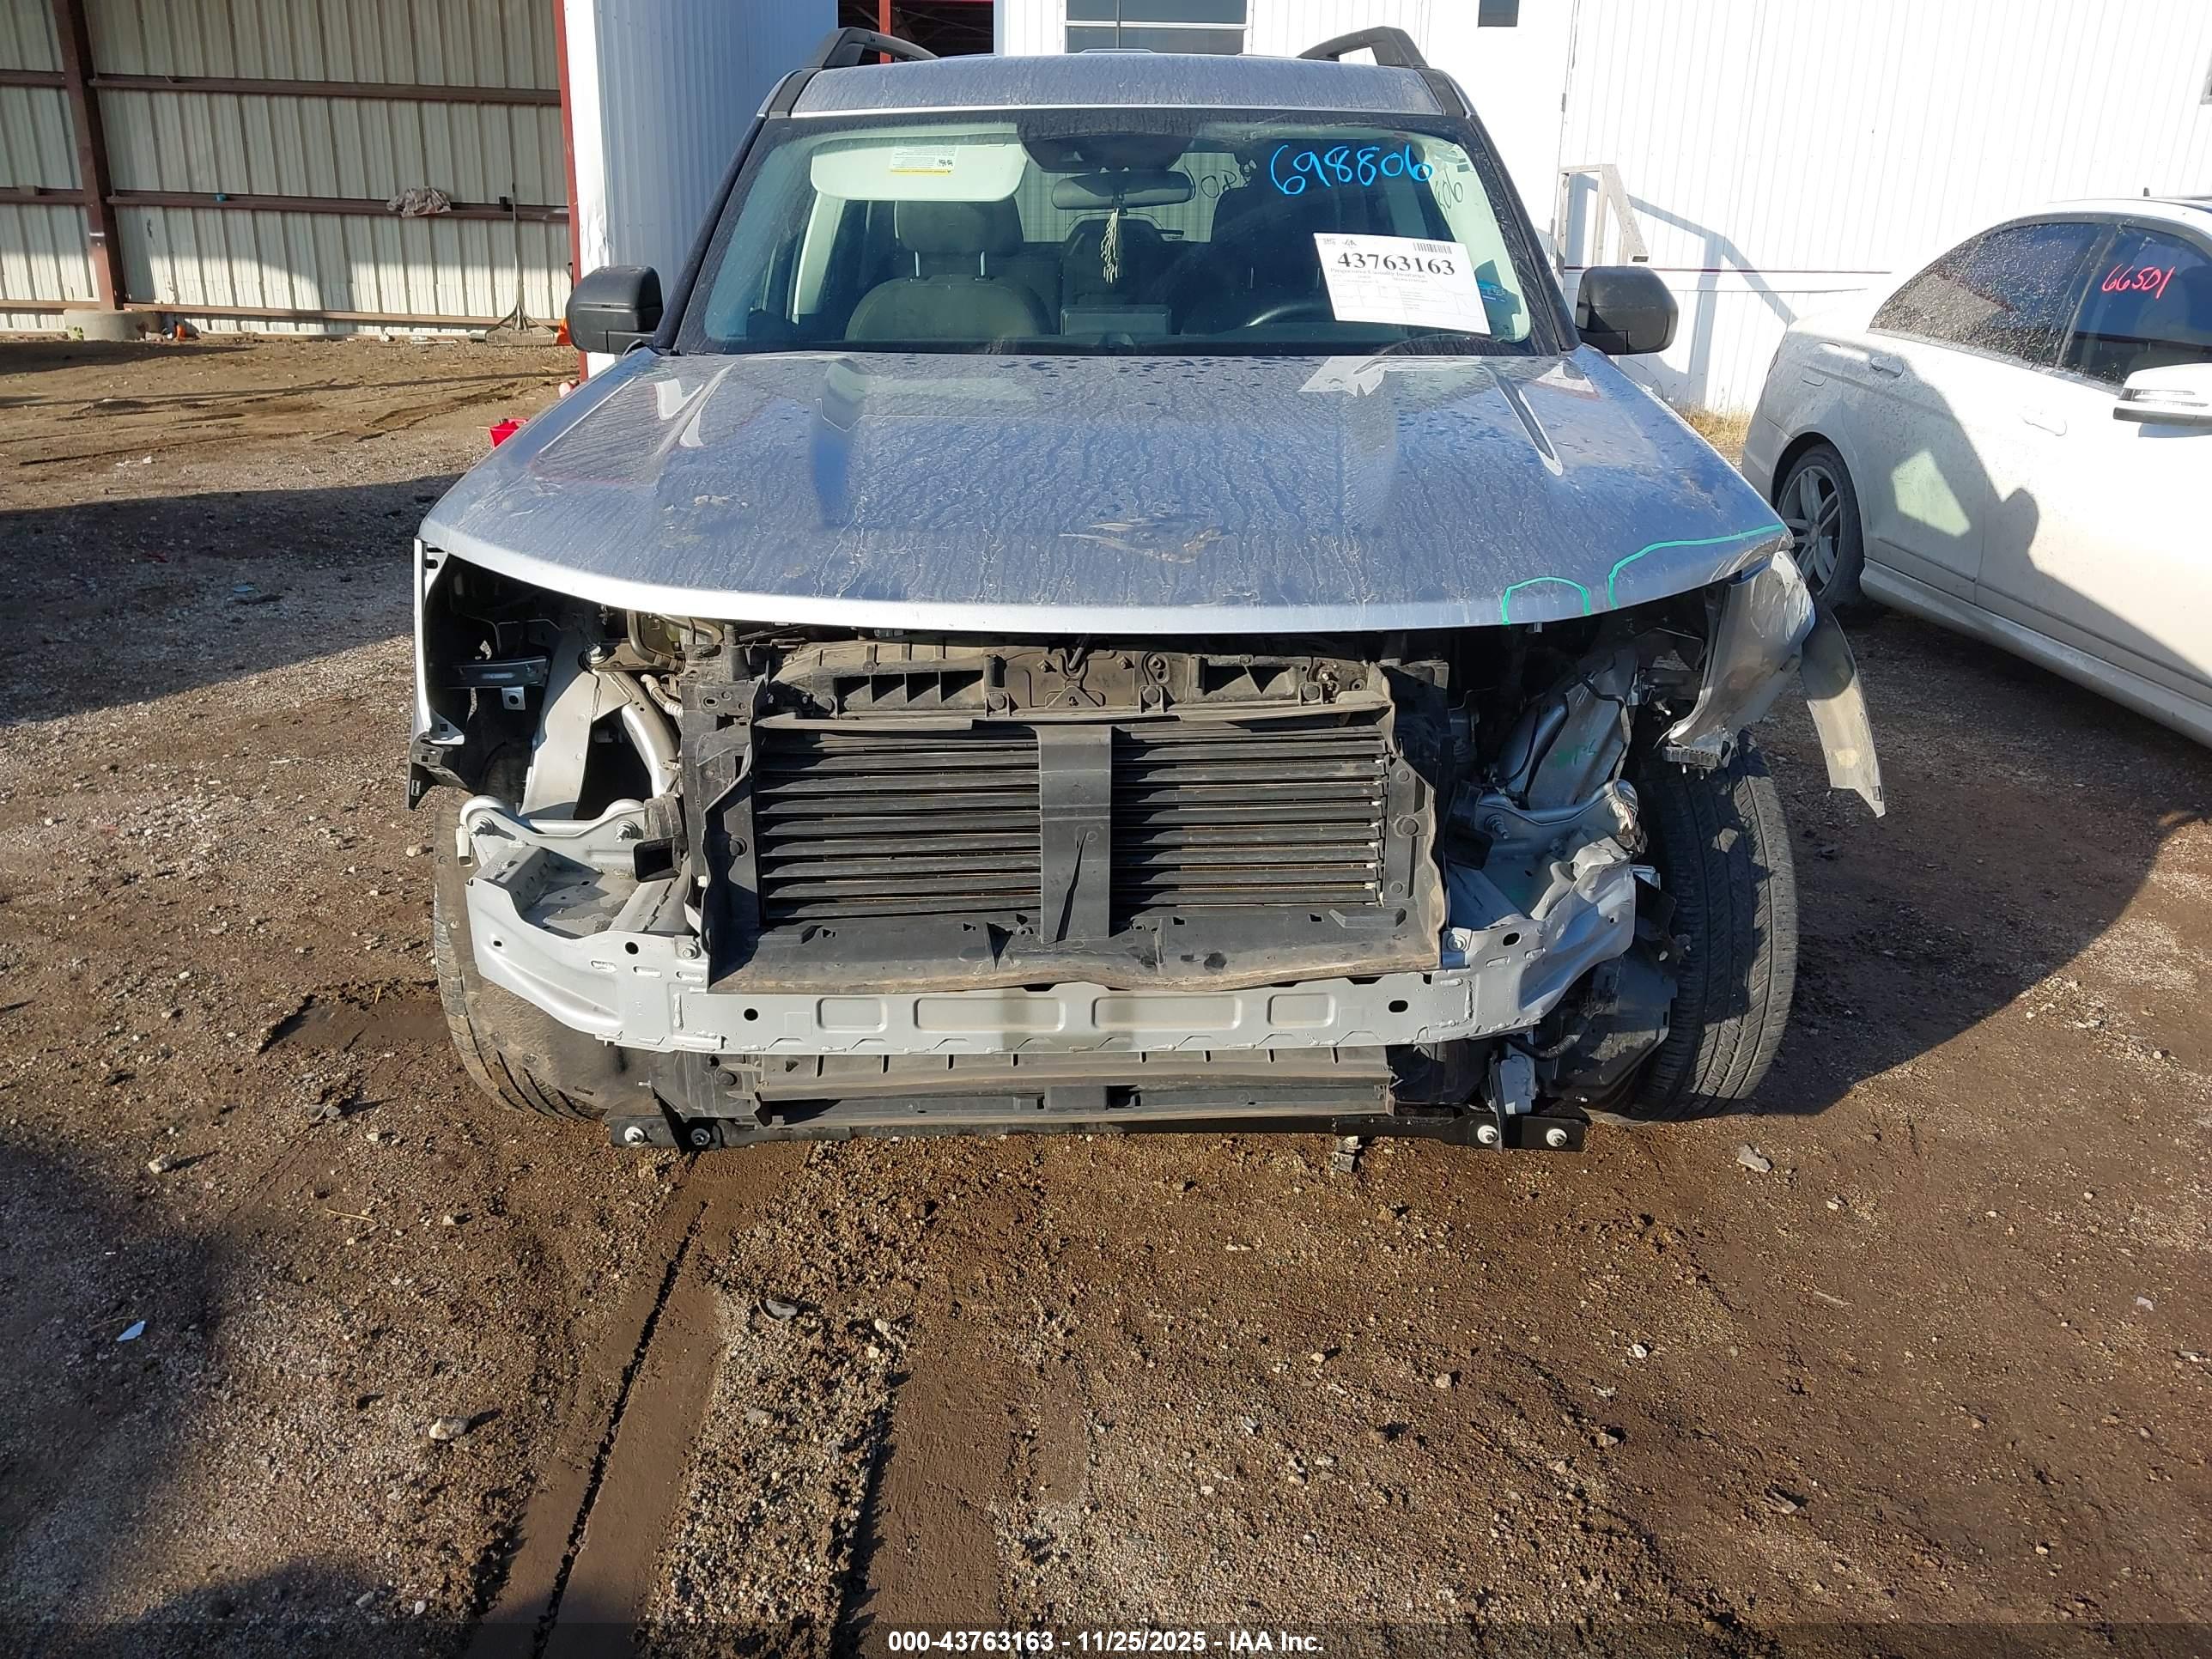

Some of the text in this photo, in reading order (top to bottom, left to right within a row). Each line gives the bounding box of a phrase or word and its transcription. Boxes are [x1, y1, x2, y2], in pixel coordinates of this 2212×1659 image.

[1270, 144, 1433, 196] 698806
[1336, 251, 1455, 276] 43763163
[2101, 263, 2176, 300] 66501
